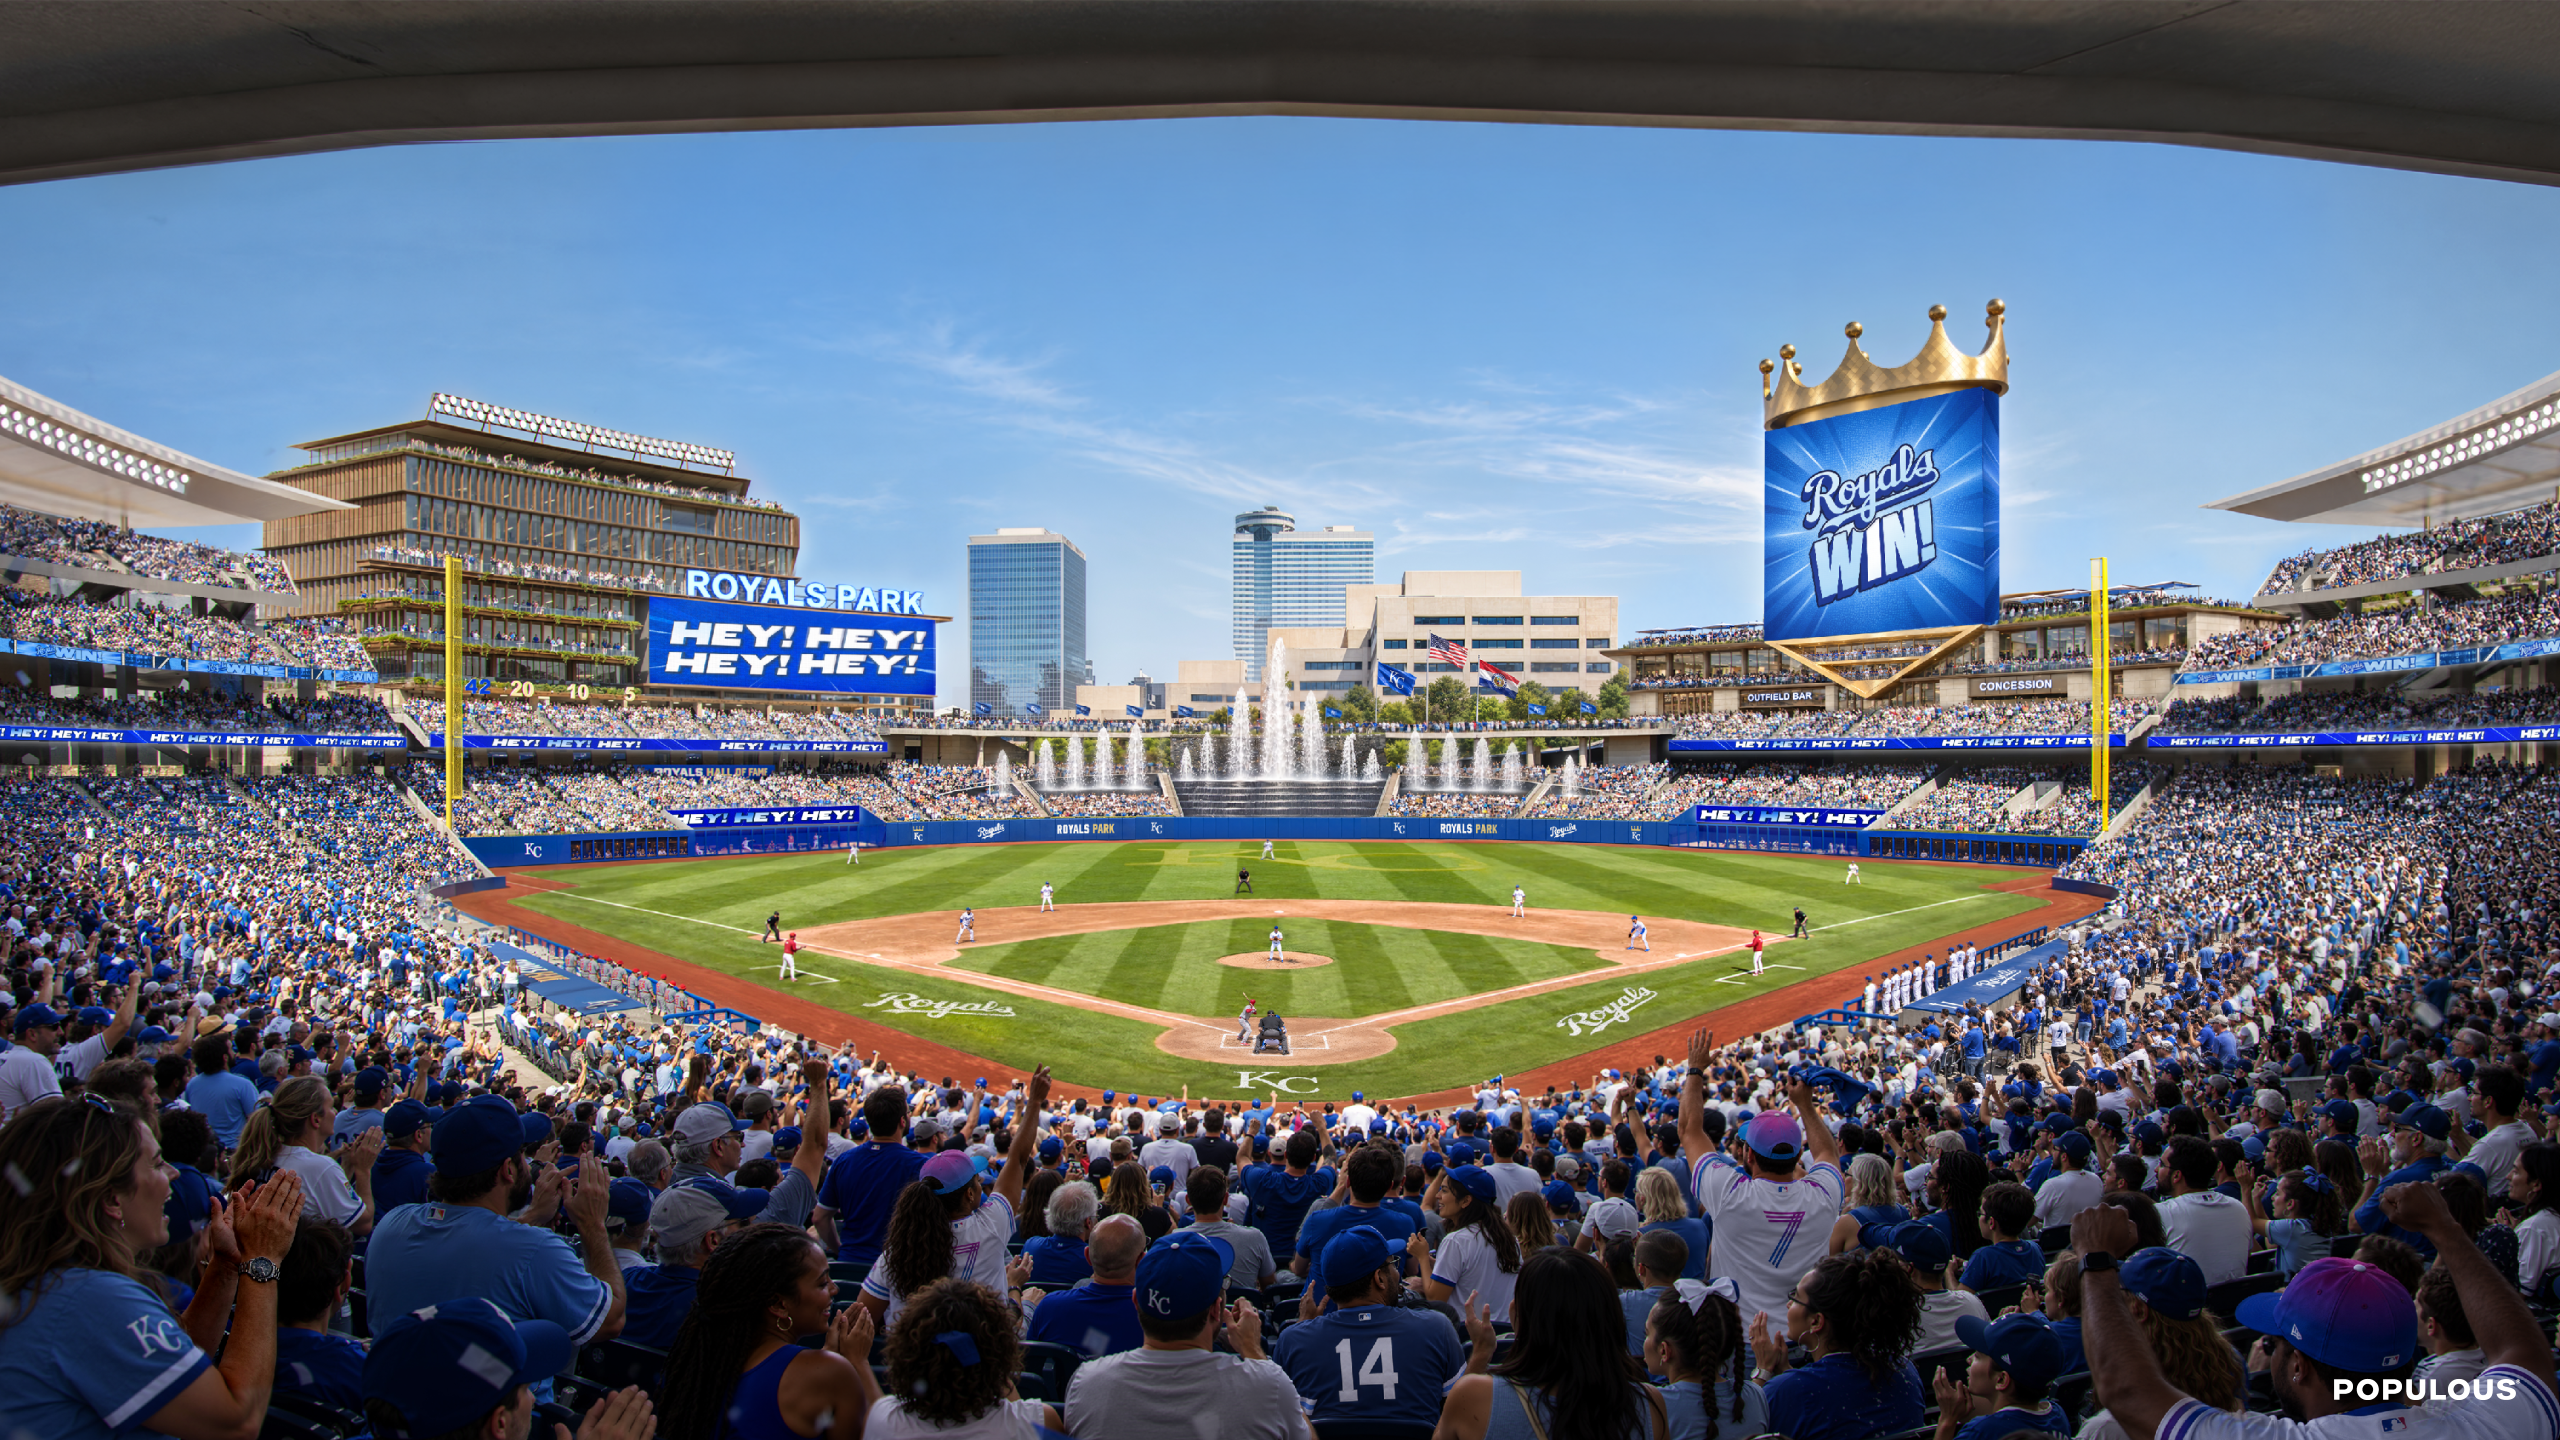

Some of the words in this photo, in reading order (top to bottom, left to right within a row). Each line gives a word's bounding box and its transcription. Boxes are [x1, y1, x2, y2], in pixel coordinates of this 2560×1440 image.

[1801, 444, 1940, 538] Royals
[1809, 498, 1937, 608] WIN!
[686, 569, 827, 609] ROYALS
[835, 584, 924, 615] PARK
[670, 621, 796, 648] HEY!
[805, 626, 927, 650] HEY!
[227, 664, 269, 675] WIN!
[665, 651, 791, 676] HEY!
[798, 653, 919, 675] HEY!
[2364, 657, 2416, 672] WIN!
[1390, 670, 1405, 690] KC
[2216, 671, 2257, 682] WIN!
[465, 679, 491, 695] 42
[510, 680, 534, 697] 20
[566, 684, 589, 700] 10
[624, 687, 635, 701] 5
[1979, 679, 2053, 691] CONCESSION
[1748, 692, 1790, 701] OUTFIELD
[1792, 691, 1812, 701] BAR
[10, 728, 47, 738] HEY!
[52, 730, 87, 739] HEY!
[91, 731, 124, 740] HEY!
[150, 733, 184, 742] HEY!
[188, 734, 222, 743] HEY!
[226, 735, 259, 744] HEY!
[263, 736, 295, 745] HEY!
[2356, 734, 2390, 742] HEY!
[2392, 733, 2422, 742] HEY!
[2427, 732, 2455, 741] HEY!
[2457, 731, 2485, 740] HEY!
[2520, 728, 2554, 738] HEY!
[315, 737, 338, 745] HEY!
[340, 738, 359, 746] HEY!
[383, 739, 404, 747] HEY!
[492, 738, 540, 747] HEY!
[547, 739, 592, 748] HEY!
[597, 740, 642, 748] HEY!
[720, 742, 764, 750] HEY!
[813, 743, 847, 751] HEY!
[1812, 740, 1846, 748] HEY!
[1942, 739, 1979, 747] HEY!
[1983, 738, 2019, 746] HEY!
[2239, 737, 2274, 745] HEY!
[2279, 736, 2316, 744] HEY!
[654, 767, 704, 776] ROYALS
[706, 768, 733, 777] HALL
[735, 768, 746, 776] OF
[748, 768, 768, 776] FAME
[734, 811, 794, 823] HEY!
[801, 810, 855, 821] HEY!
[1700, 810, 1754, 821] HEY!
[1759, 811, 1818, 823] HEY!
[1057, 824, 1090, 835] ROYALS
[1092, 823, 1115, 834] PARK
[1150, 822, 1163, 835] KC
[1393, 822, 1406, 834] KC
[1440, 823, 1473, 834] ROYALS
[1475, 823, 1498, 834] PARK
[1550, 823, 1577, 838] Royals
[913, 832, 924, 842] KC
[1631, 832, 1641, 842] KC
[524, 842, 542, 858] KC
[862, 992, 1016, 1019] Royals
[1556, 984, 1658, 1036] Royals
[2057, 1030, 2063, 1040] 7
[1233, 1071, 1320, 1094] KC
[1763, 1210, 1806, 1268] 7
[954, 1241, 981, 1282] 7
[1148, 1288, 1171, 1315] KC
[127, 1314, 183, 1360] KC
[1335, 1336, 1399, 1402] 14
